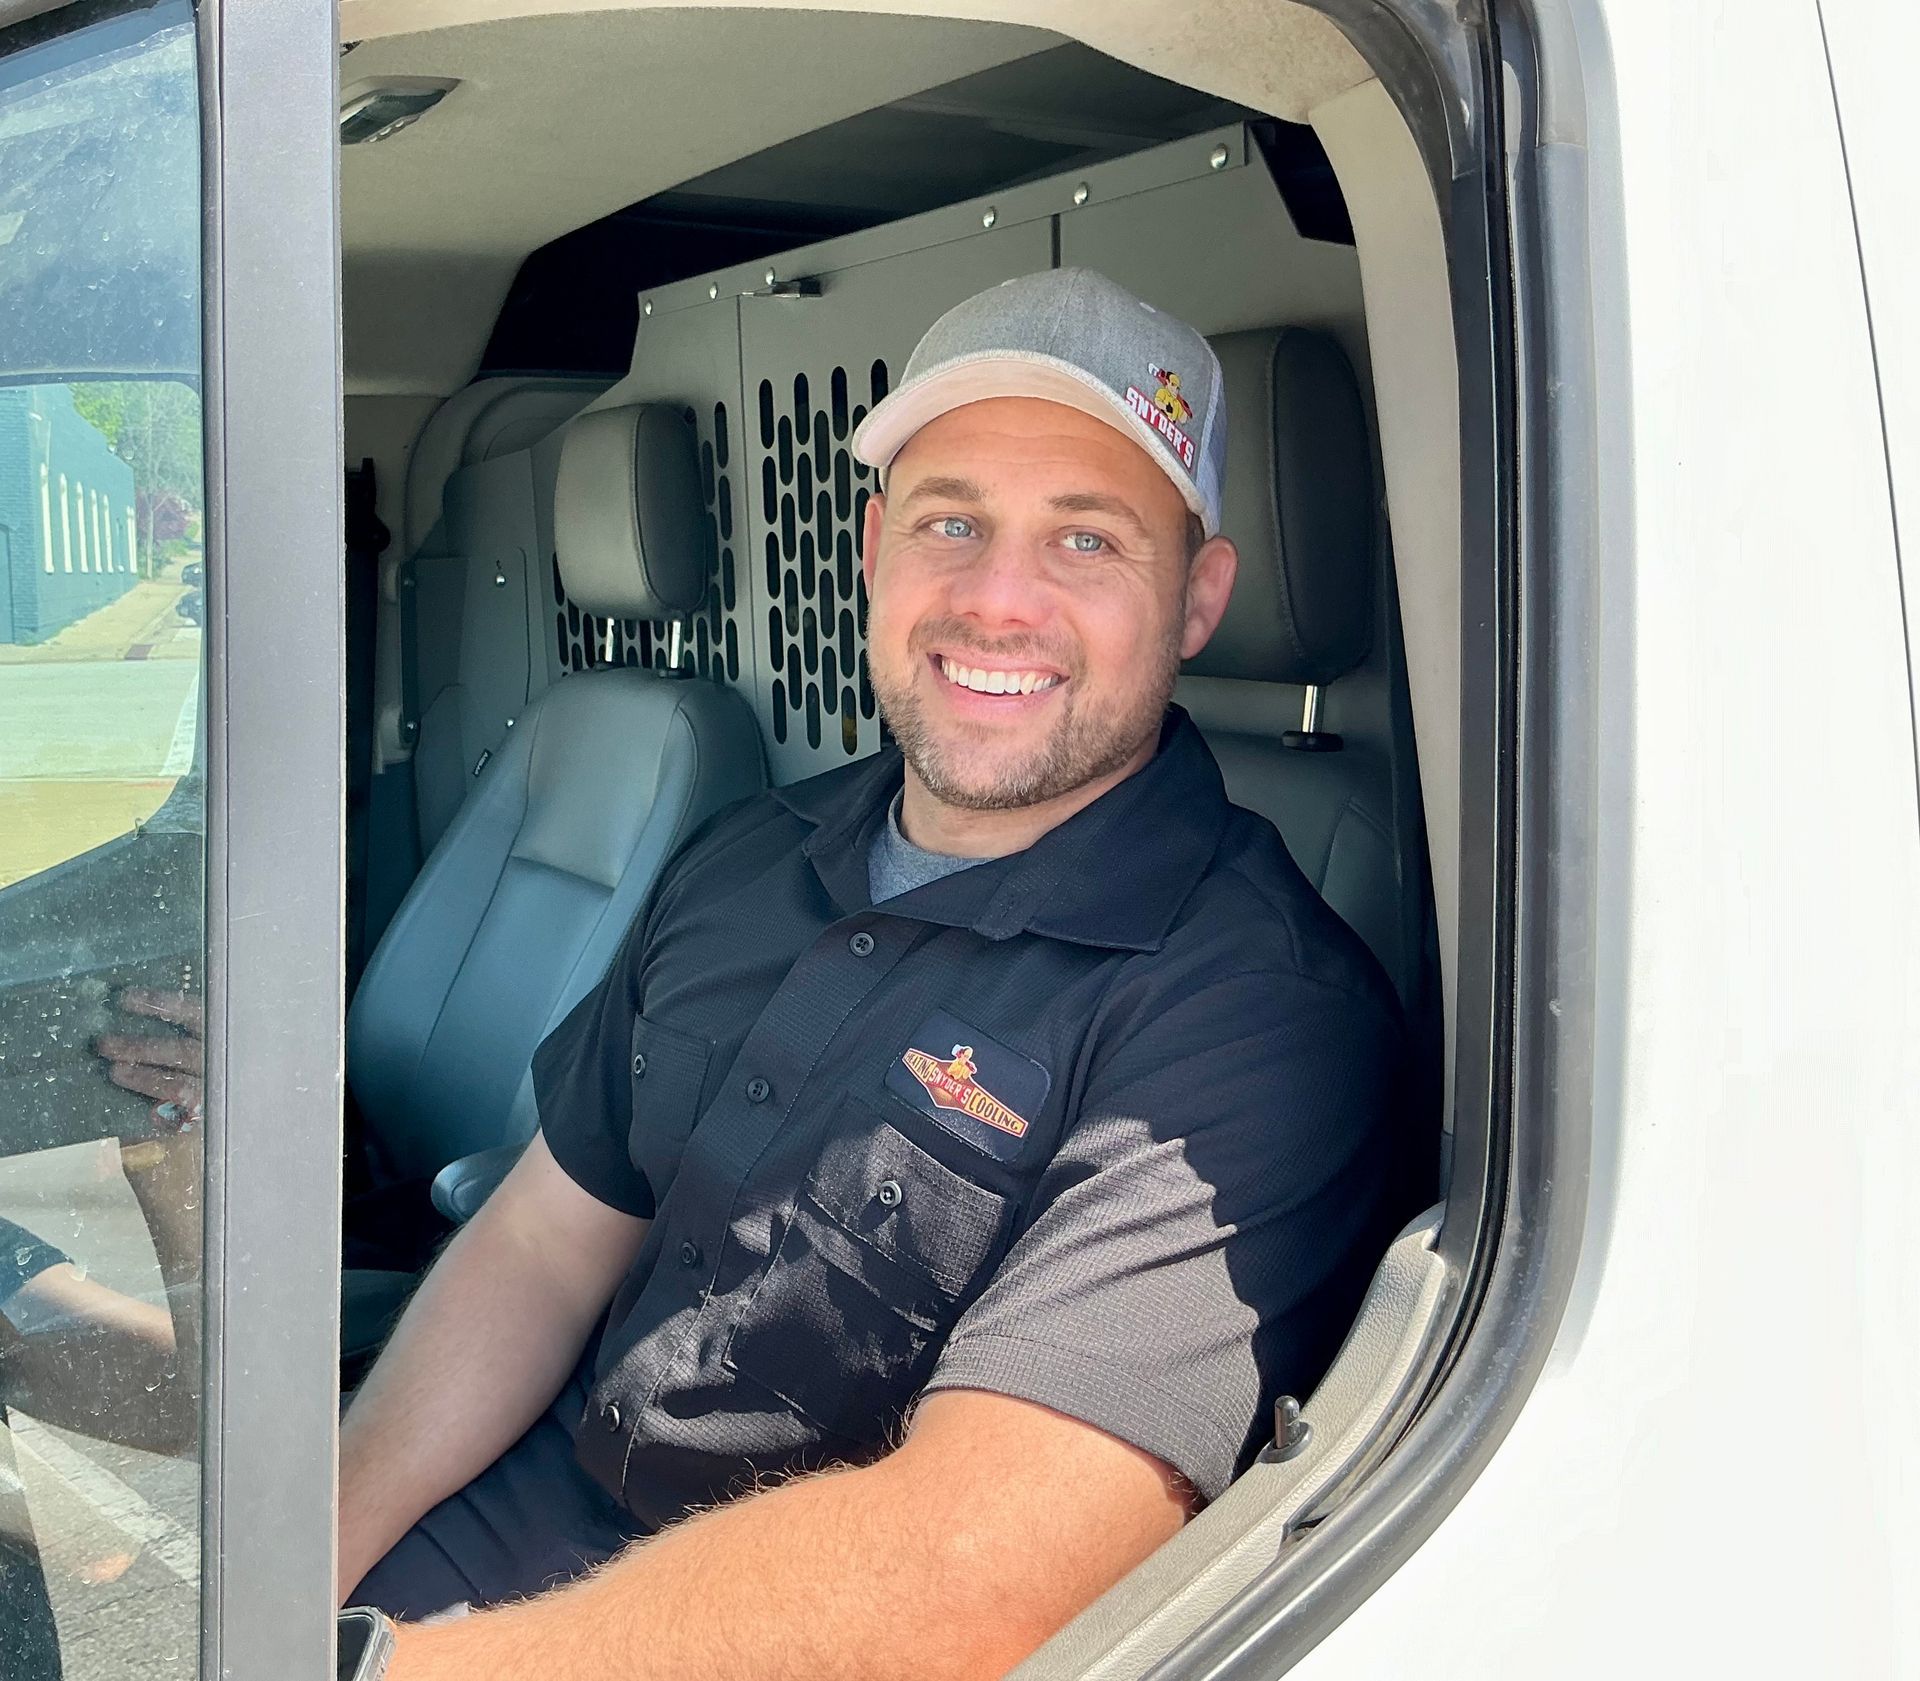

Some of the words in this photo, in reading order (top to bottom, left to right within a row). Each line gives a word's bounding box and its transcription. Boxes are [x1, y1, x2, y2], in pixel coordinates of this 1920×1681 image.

[1125, 386, 1195, 469] SNYDER'S
[906, 1051, 934, 1081] HEATING
[929, 1069, 970, 1104] SNYDER'S
[969, 1091, 1018, 1131] COOLING
